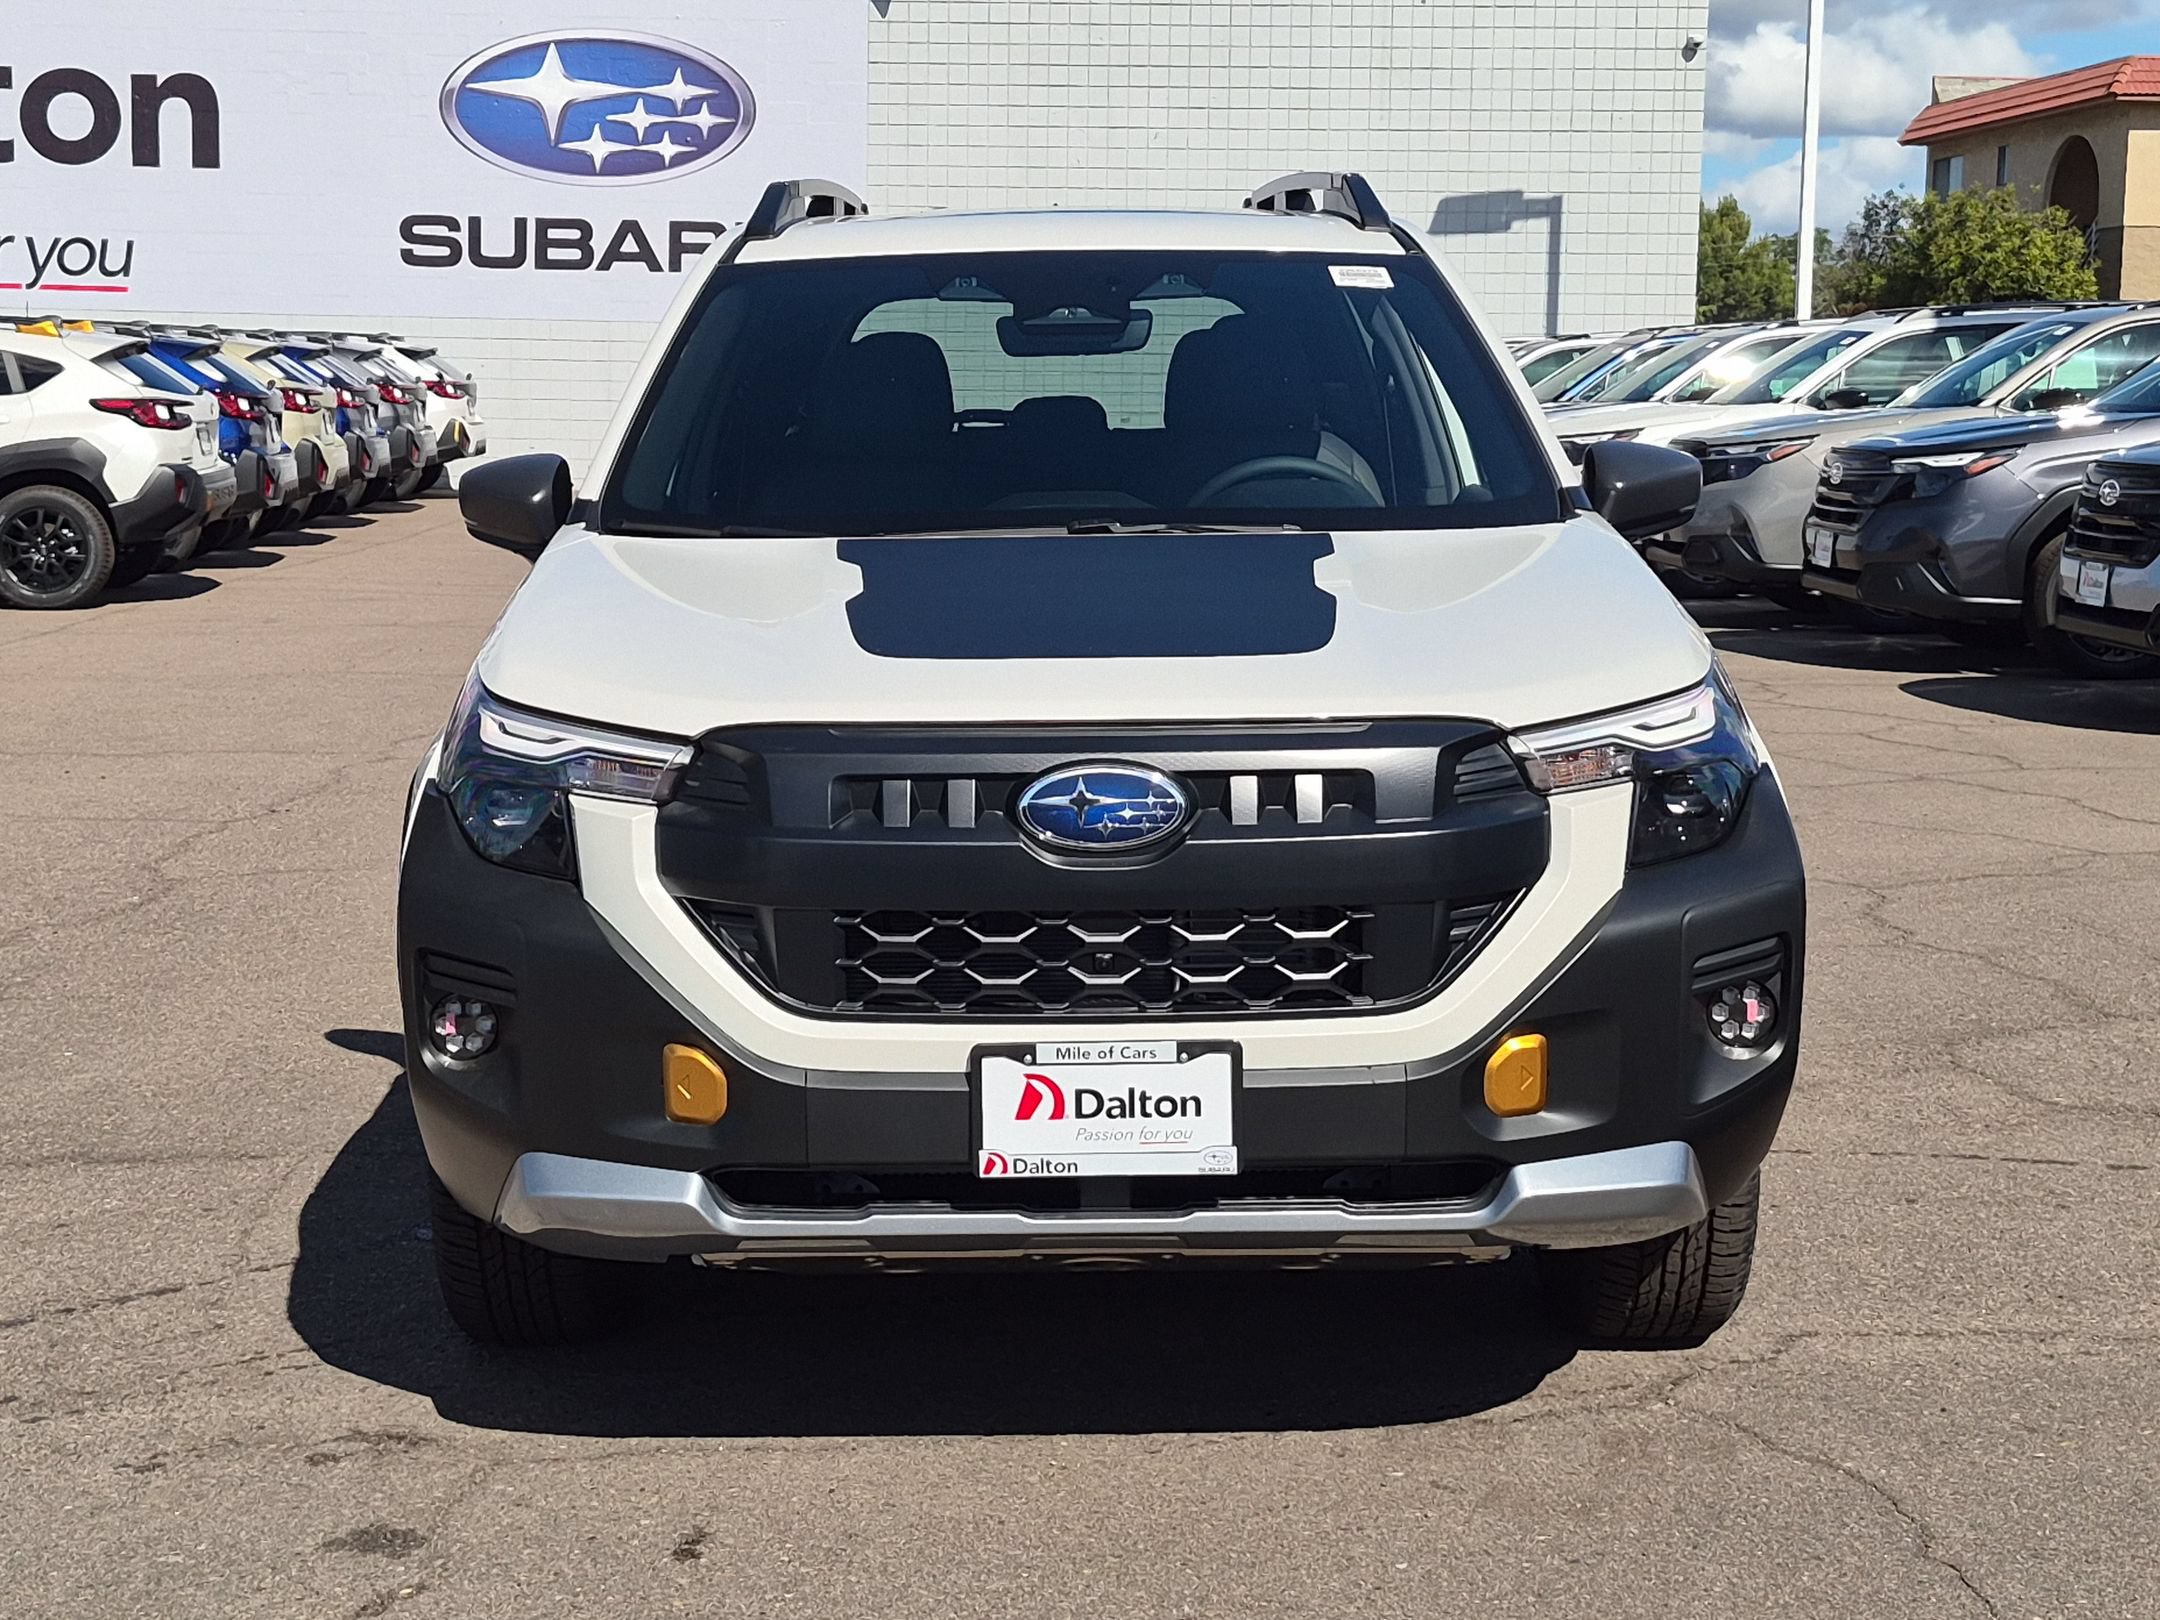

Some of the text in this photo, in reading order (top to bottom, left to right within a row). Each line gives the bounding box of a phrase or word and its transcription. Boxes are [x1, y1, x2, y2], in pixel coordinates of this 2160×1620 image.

[399, 214, 745, 273] SUBAR
[25, 235, 135, 290] you
[1056, 1046, 1157, 1060] Mile of Cars
[1075, 1087, 1201, 1119] Dalton
[1075, 1126, 1193, 1144] Passion for you
[1013, 1158, 1078, 1174] Dalton
